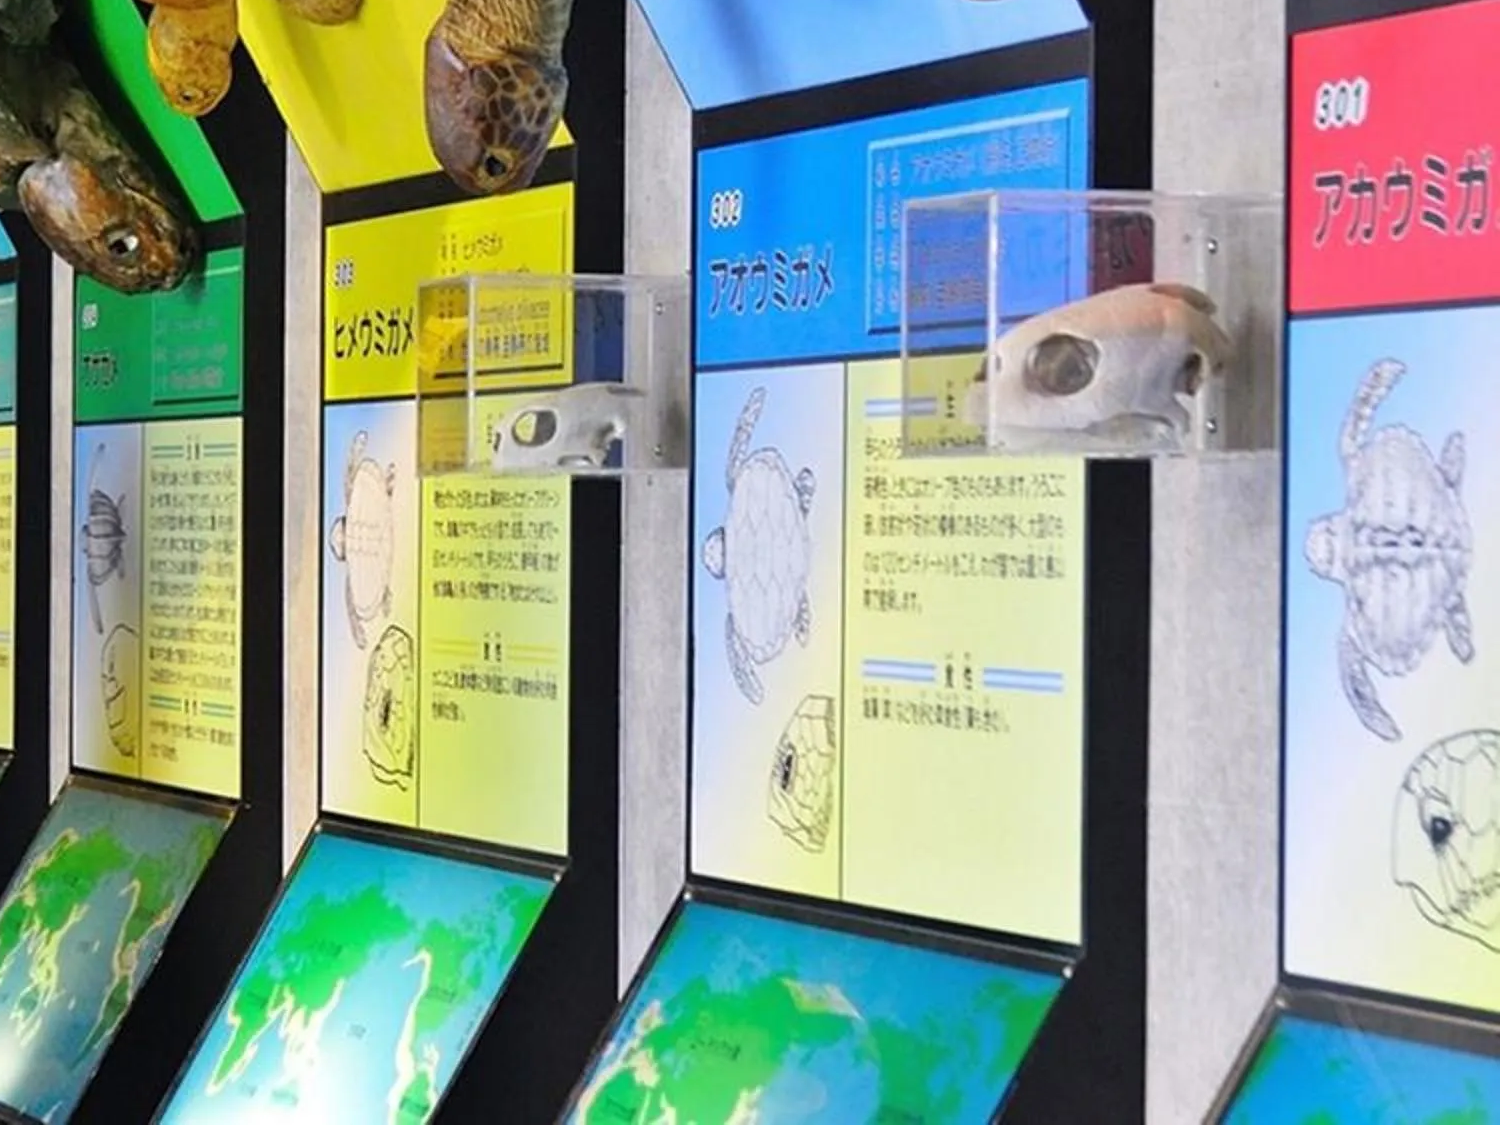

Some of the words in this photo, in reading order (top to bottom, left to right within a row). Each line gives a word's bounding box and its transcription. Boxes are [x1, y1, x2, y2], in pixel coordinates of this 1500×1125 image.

[1314, 76, 1370, 131] 301
[709, 188, 744, 229] 302
[1312, 144, 1500, 249] アカウミガ
[708, 243, 834, 317] アオウミガメ
[333, 307, 416, 359] ヒメウミガメ
